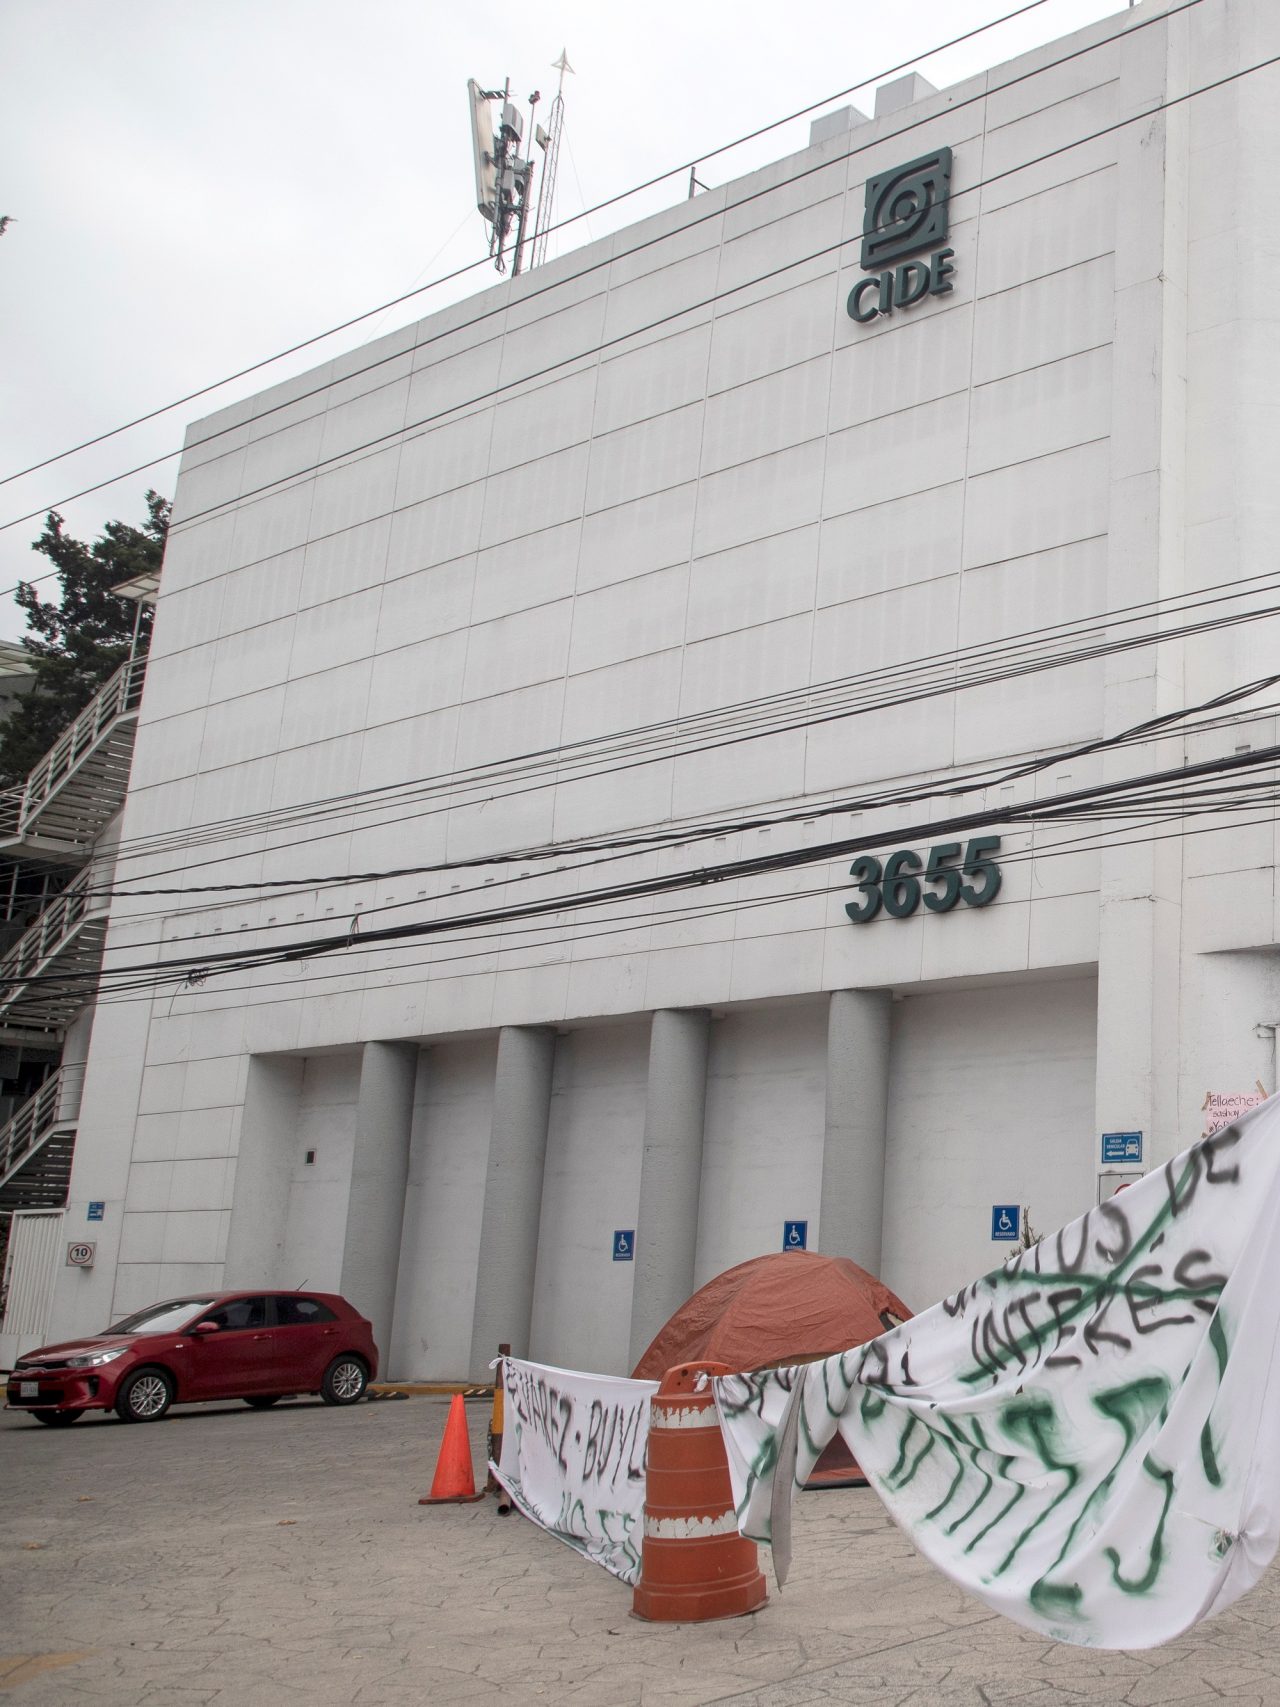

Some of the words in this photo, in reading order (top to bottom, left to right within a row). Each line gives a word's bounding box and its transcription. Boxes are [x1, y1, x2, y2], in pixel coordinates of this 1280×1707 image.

[847, 248, 955, 323] CIDE
[845, 835, 1002, 923] 3655
[75, 1248, 88, 1257] 10
